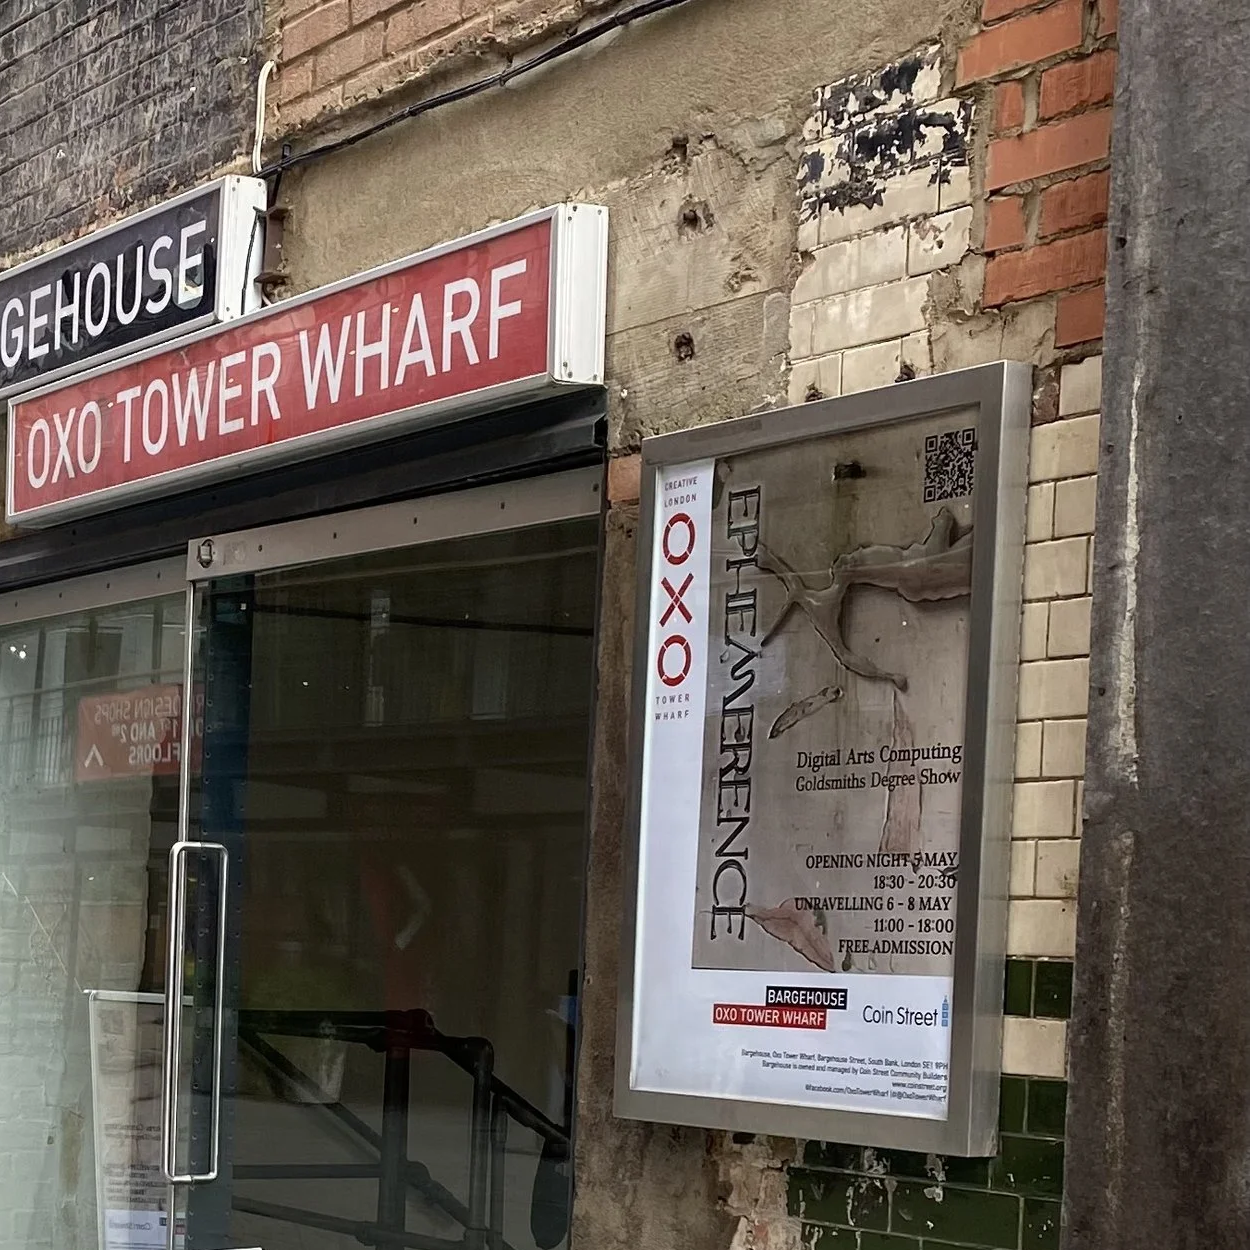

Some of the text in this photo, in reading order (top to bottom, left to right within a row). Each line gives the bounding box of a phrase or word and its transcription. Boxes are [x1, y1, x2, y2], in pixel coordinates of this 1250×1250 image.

[26, 258, 528, 490] OXO TOWER WHARF
[664, 476, 698, 491] CREATIVE
[664, 493, 697, 508] LONDON
[657, 512, 696, 687] OXO
[655, 693, 690, 705] TOWER
[654, 709, 690, 721] WHARF
[796, 743, 963, 772] Digital Arts Computing
[795, 768, 962, 792] Goldsmiths Degree Show
[806, 851, 958, 869] OPENING NIGHT 5 MAY
[873, 874, 957, 890] 18:30 20:30
[794, 896, 953, 912] UNRAVELLING 6 8 MAY
[873, 918, 954, 933] 11:00 18:00
[838, 938, 954, 956] FREE ADMISSION
[768, 988, 846, 1007] BARGEHOUSE
[715, 1007, 825, 1026] OXO TOWER WHARF
[862, 1005, 938, 1027] Coin Street
